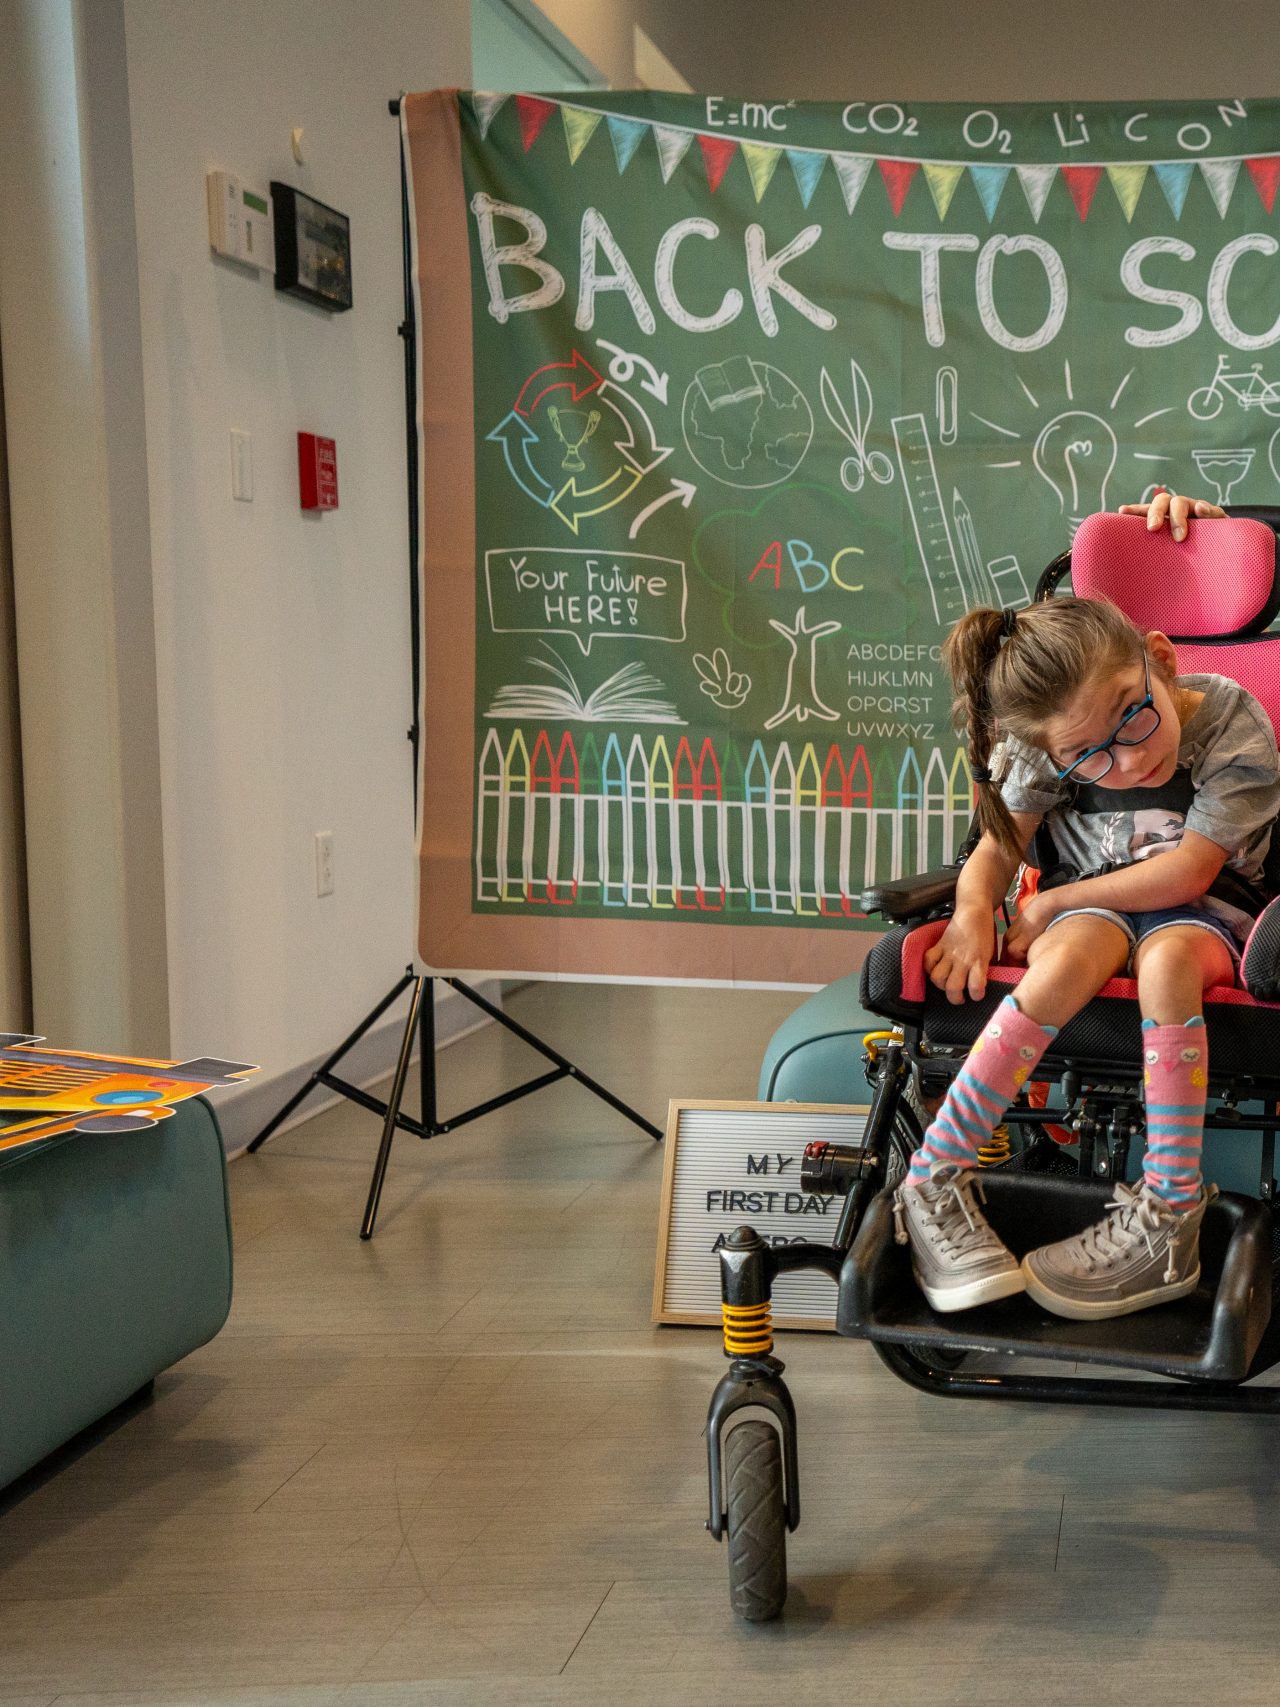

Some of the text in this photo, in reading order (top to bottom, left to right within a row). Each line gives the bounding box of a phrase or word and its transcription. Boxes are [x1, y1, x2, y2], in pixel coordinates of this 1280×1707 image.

[1054, 113, 1090, 147] Li
[1124, 113, 1148, 142] C
[1218, 99, 1247, 126] N
[470, 192, 837, 337] BACK
[882, 231, 1069, 352] TO
[509, 556, 668, 596] Your Future
[748, 539, 865, 593] ABC
[543, 594, 638, 626] HERE!
[847, 670, 933, 688] HIJKLMN
[846, 695, 933, 714] OPQRST
[846, 721, 935, 740] UVWXYZ
[746, 1153, 793, 1175] MY
[706, 1189, 835, 1215] FIRST DAY
